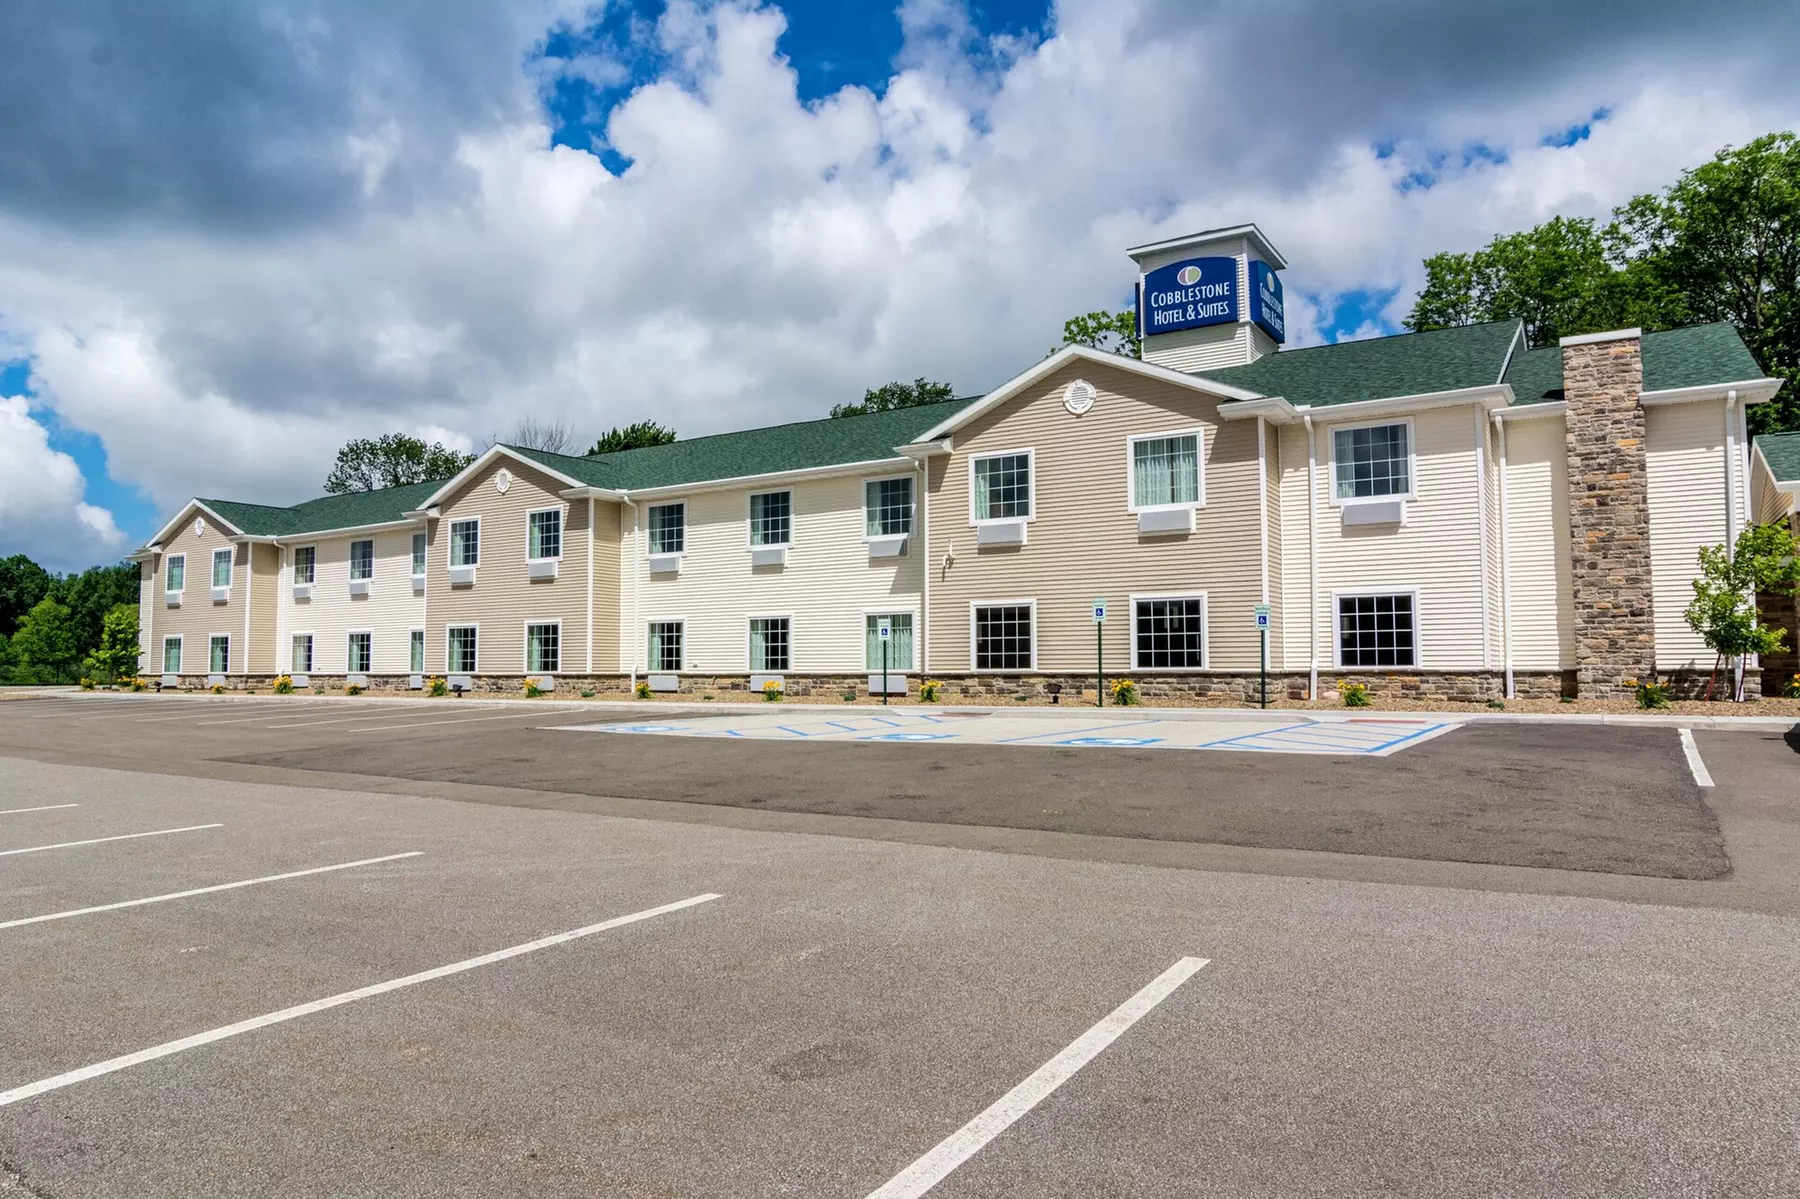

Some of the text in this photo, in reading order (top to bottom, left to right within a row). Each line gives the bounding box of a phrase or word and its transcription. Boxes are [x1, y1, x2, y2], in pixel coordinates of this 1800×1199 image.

[1151, 282, 1230, 308] COBBLESTONE
[1154, 301, 1229, 326] HOTEL & SUITES
